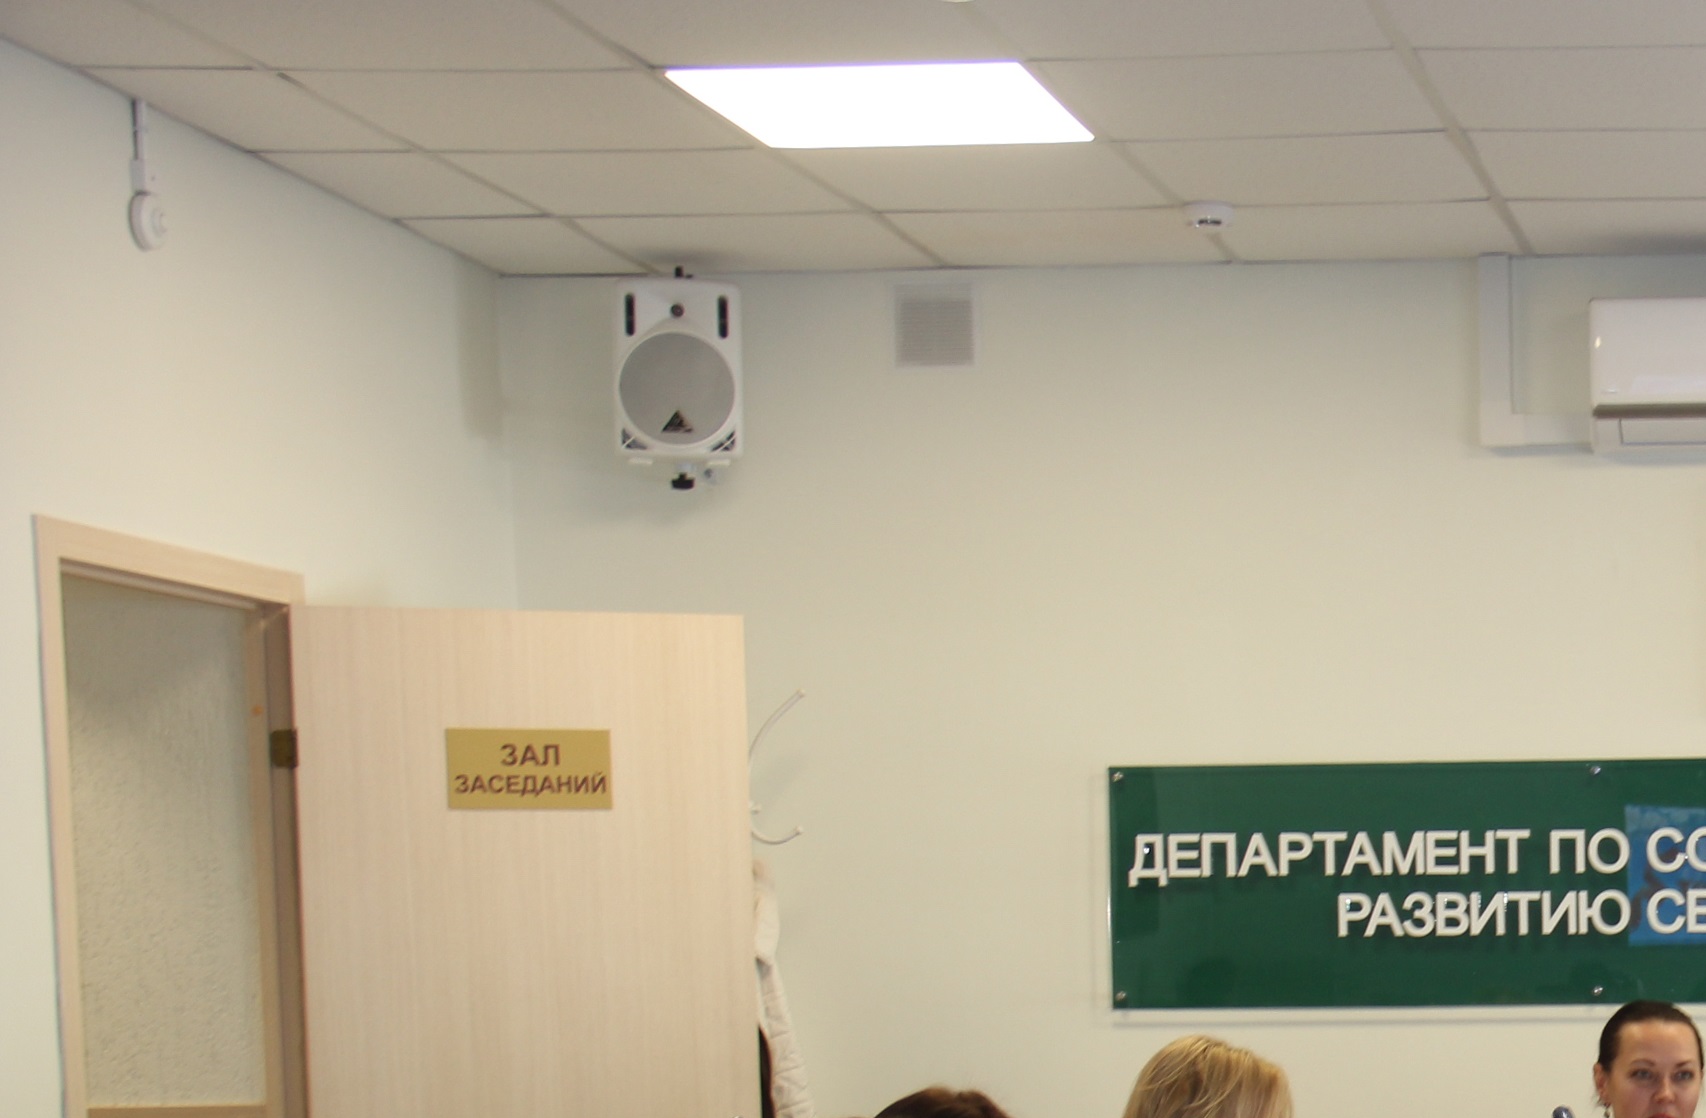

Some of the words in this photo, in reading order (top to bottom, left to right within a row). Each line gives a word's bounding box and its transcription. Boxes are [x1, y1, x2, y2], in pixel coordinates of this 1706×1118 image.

[501, 743, 560, 766] ЗАЛ
[454, 771, 607, 797] ЗАСЕДАНИЙ
[1128, 829, 1531, 887] ДЕПАРТАМЕНТ
[1549, 827, 1630, 875] ПО
[1337, 888, 1631, 938] РАЗВИТИЮ
